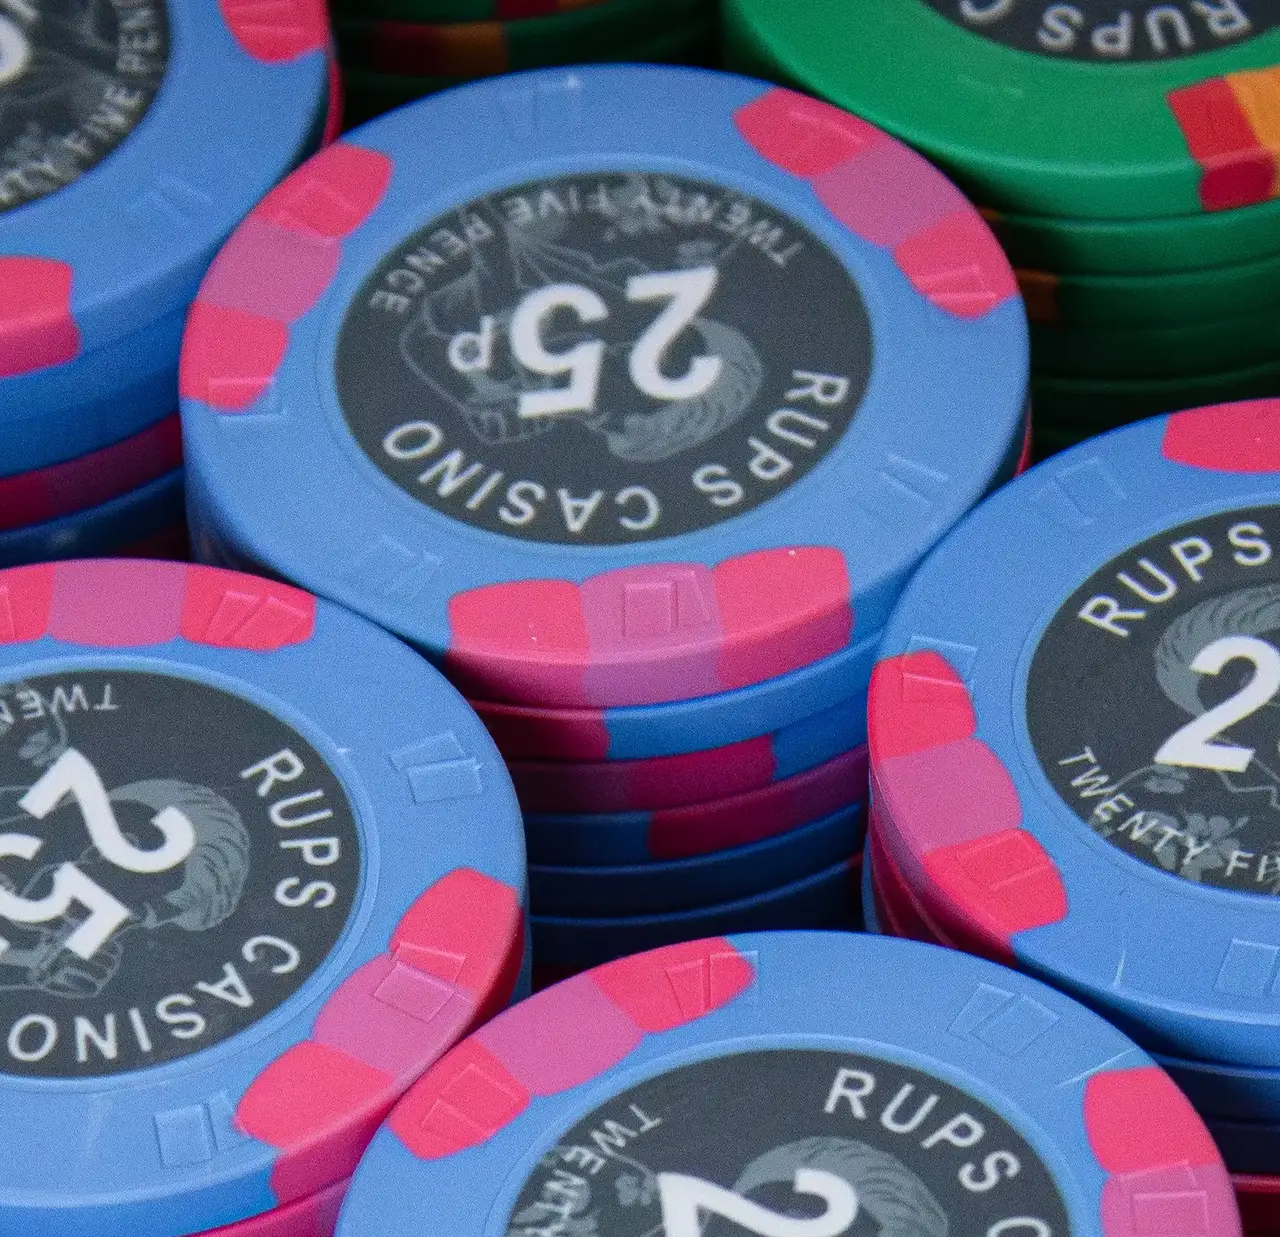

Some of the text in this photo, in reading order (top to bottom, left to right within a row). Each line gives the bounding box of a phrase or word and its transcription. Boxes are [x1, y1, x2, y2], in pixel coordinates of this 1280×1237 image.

[1036, 0, 1252, 57] RUPS
[72, 84, 144, 158] FIVE
[370, 180, 805, 315] TWENTY FIVE PENCE
[447, 264, 722, 419] 25p
[381, 368, 850, 535] RUPS CASINO
[1077, 520, 1273, 637] RUPS
[1057, 745, 1214, 868] TWENTY
[6, 746, 340, 1064] RUPS CASINO
[822, 1066, 1022, 1194] RUPS
